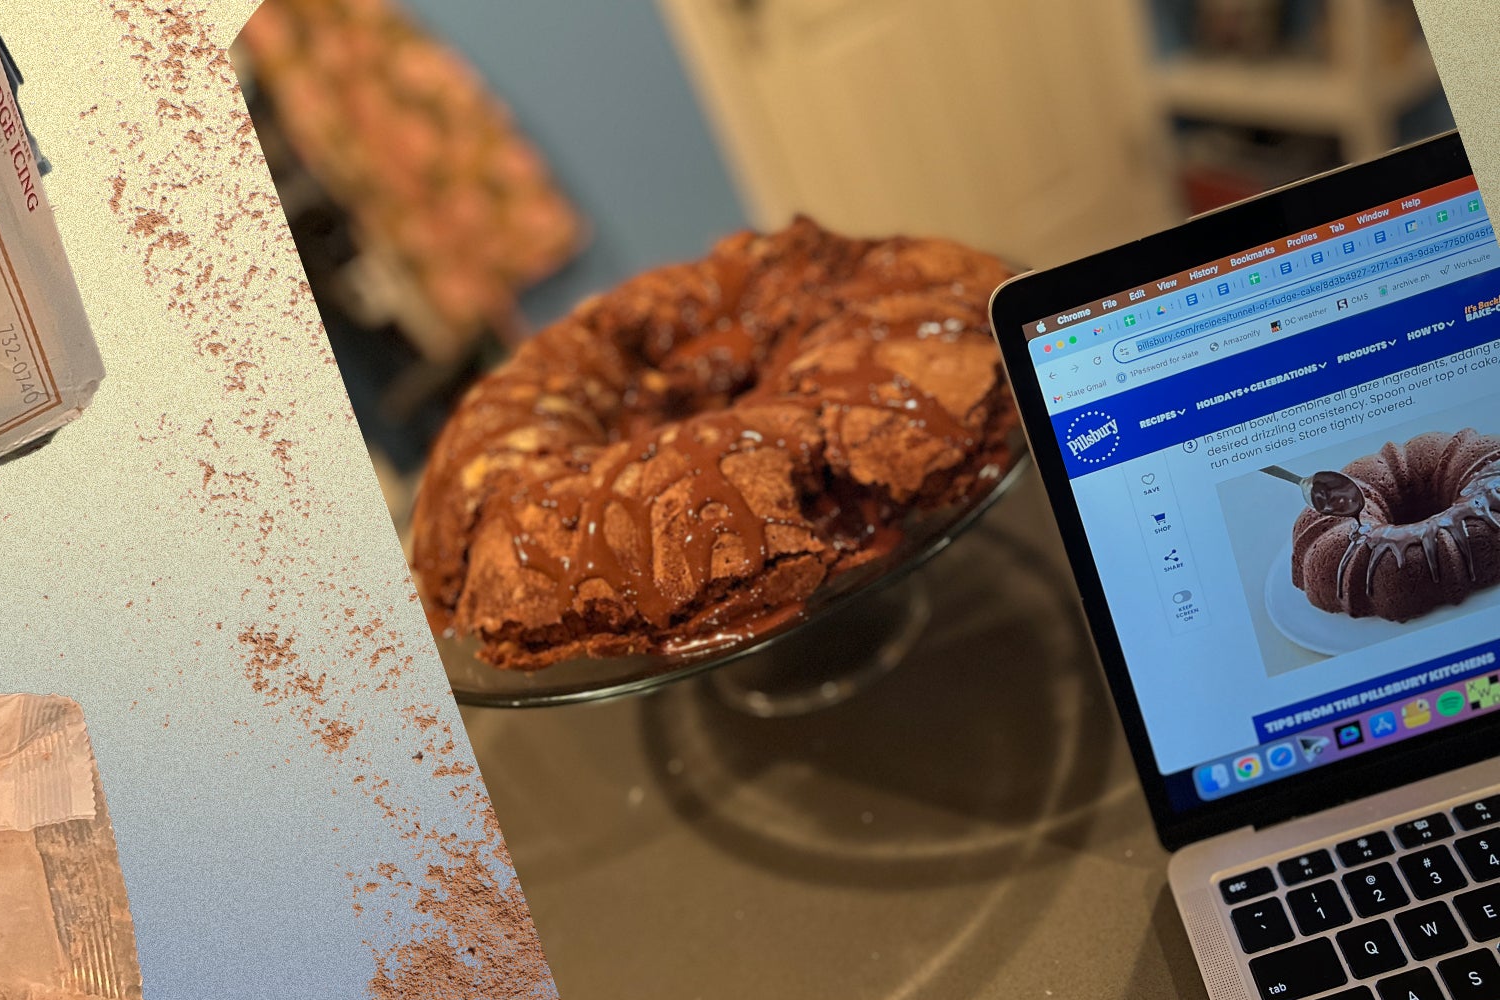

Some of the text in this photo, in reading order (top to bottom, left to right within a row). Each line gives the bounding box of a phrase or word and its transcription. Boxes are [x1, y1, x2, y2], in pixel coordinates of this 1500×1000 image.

[9, 139, 39, 213] ICING
[1056, 197, 1421, 326] Chrome File Edit View History Bookmarks Profiles Tab Window Help
[1452, 253, 1492, 271] Worksuite
[1350, 293, 1370, 305] CMS
[1298, 306, 1328, 323] weather
[1222, 328, 1262, 348] Amazonify
[1406, 321, 1446, 341] HOW TO
[1336, 340, 1388, 364] PRODUCTS
[1129, 349, 1200, 378] 1Password for slate
[1066, 379, 1108, 400] Slate Gmail
[1216, 422, 1247, 441] small
[1249, 412, 1280, 430] bowl,
[1281, 397, 1332, 420] combine
[1333, 390, 1348, 402] all
[1349, 380, 1380, 399] glaze
[1382, 360, 1449, 387] ingredients,
[1450, 343, 1491, 364] adding
[1206, 437, 1249, 457] desired
[1251, 421, 1297, 444] drizzling
[1298, 397, 1369, 428] consistency.
[1369, 385, 1406, 404] Spoon
[1408, 376, 1434, 392] over
[1434, 369, 1455, 383] top
[1457, 363, 1468, 376] of
[1139, 411, 1178, 429] RECIPES
[1066, 418, 1119, 457] Pillsbury
[1209, 396, 1416, 470] run down sides. Store tightly covered.
[1143, 485, 1161, 496] SAVE
[1153, 524, 1172, 535] SHOP
[1163, 561, 1185, 572] SHARE
[1263, 651, 1497, 734] TIPS FROM THE PILLSBURY KITCHENS
[1429, 871, 1443, 885] 3
[1228, 881, 1248, 894] esc
[1372, 889, 1386, 903] 2
[1316, 906, 1326, 920] 1
[1482, 903, 1498, 919] E
[1419, 921, 1440, 938] W
[1364, 941, 1380, 956] Q
[1467, 970, 1483, 986] S
[1268, 981, 1288, 996] tab
